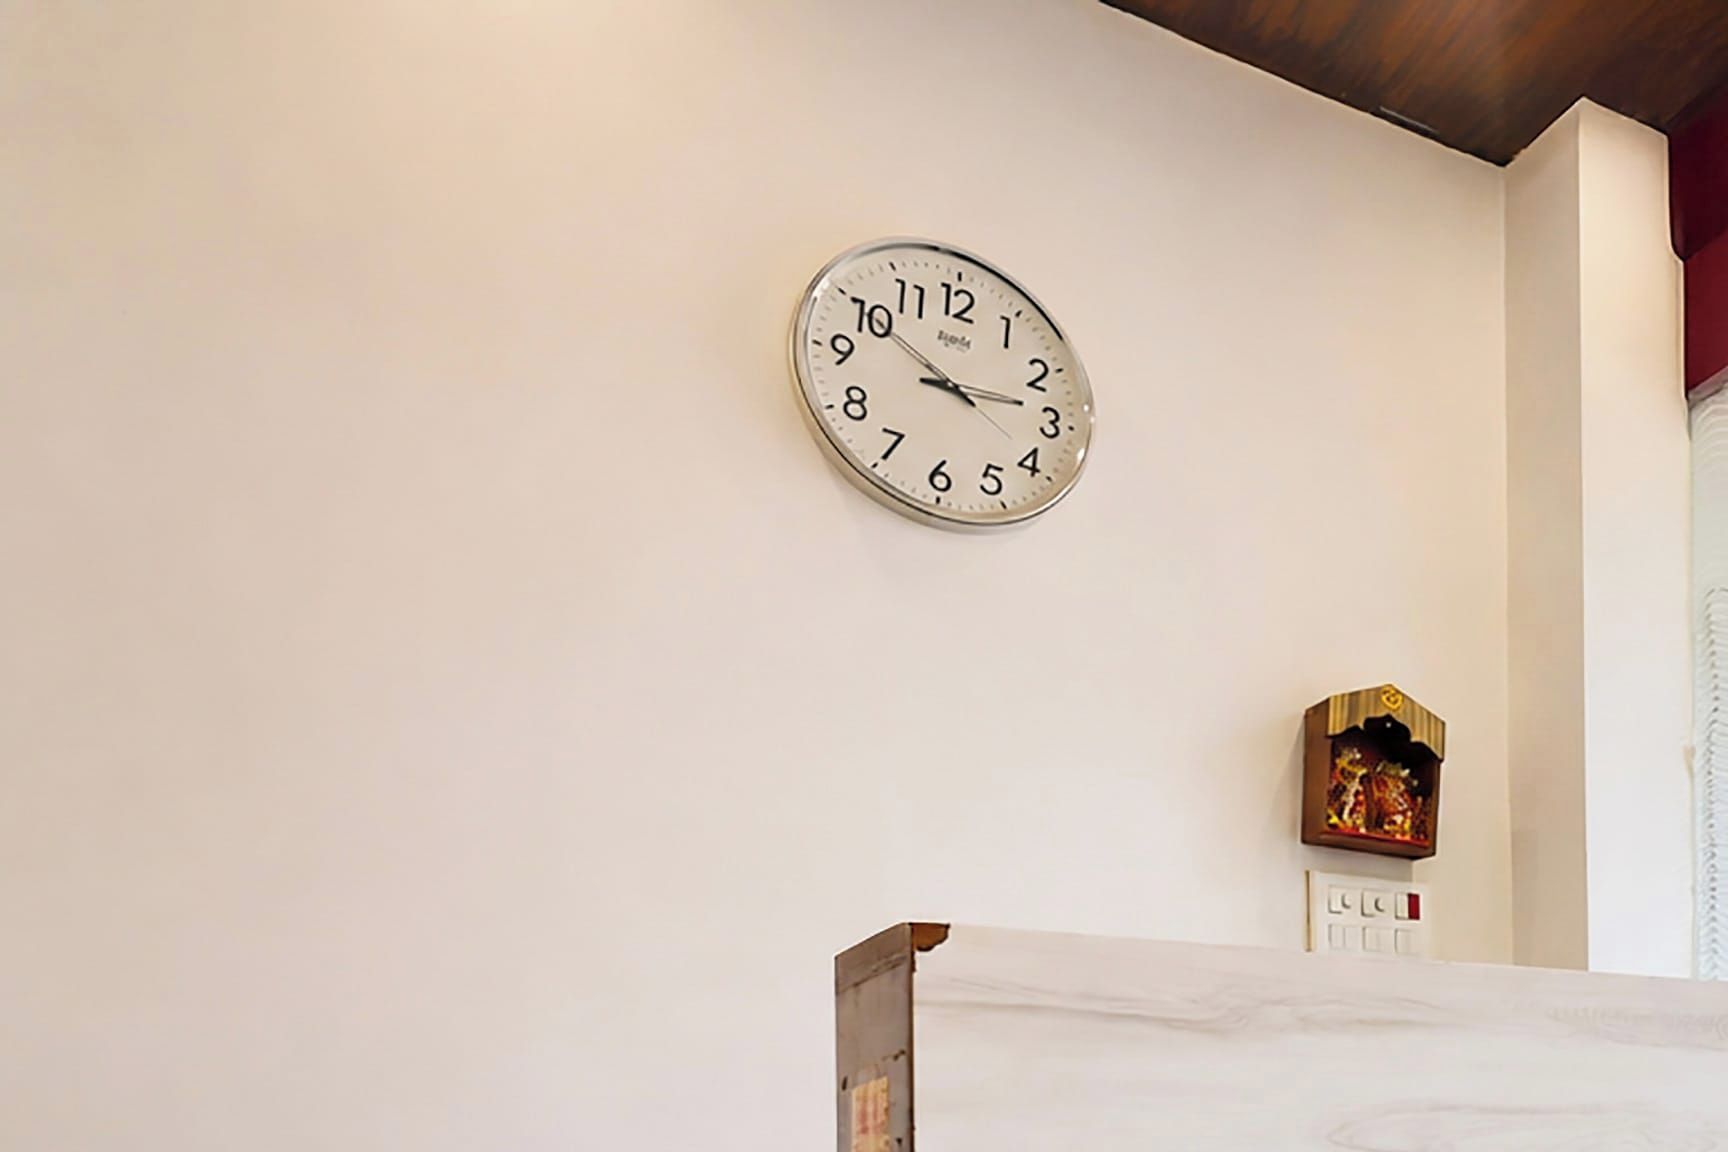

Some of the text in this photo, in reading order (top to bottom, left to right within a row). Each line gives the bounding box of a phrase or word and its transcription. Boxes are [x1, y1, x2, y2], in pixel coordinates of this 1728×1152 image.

[896, 278, 925, 320] 11
[940, 282, 976, 325] 12
[850, 296, 893, 339] 10
[1000, 315, 1011, 349] 1
[830, 333, 855, 366] 9
[1026, 358, 1050, 393] 2
[842, 385, 868, 422] 8
[1039, 406, 1061, 440] 3
[881, 427, 905, 461] 7
[928, 459, 952, 493] 6
[979, 463, 1004, 496] 5
[1017, 447, 1042, 478] 4
